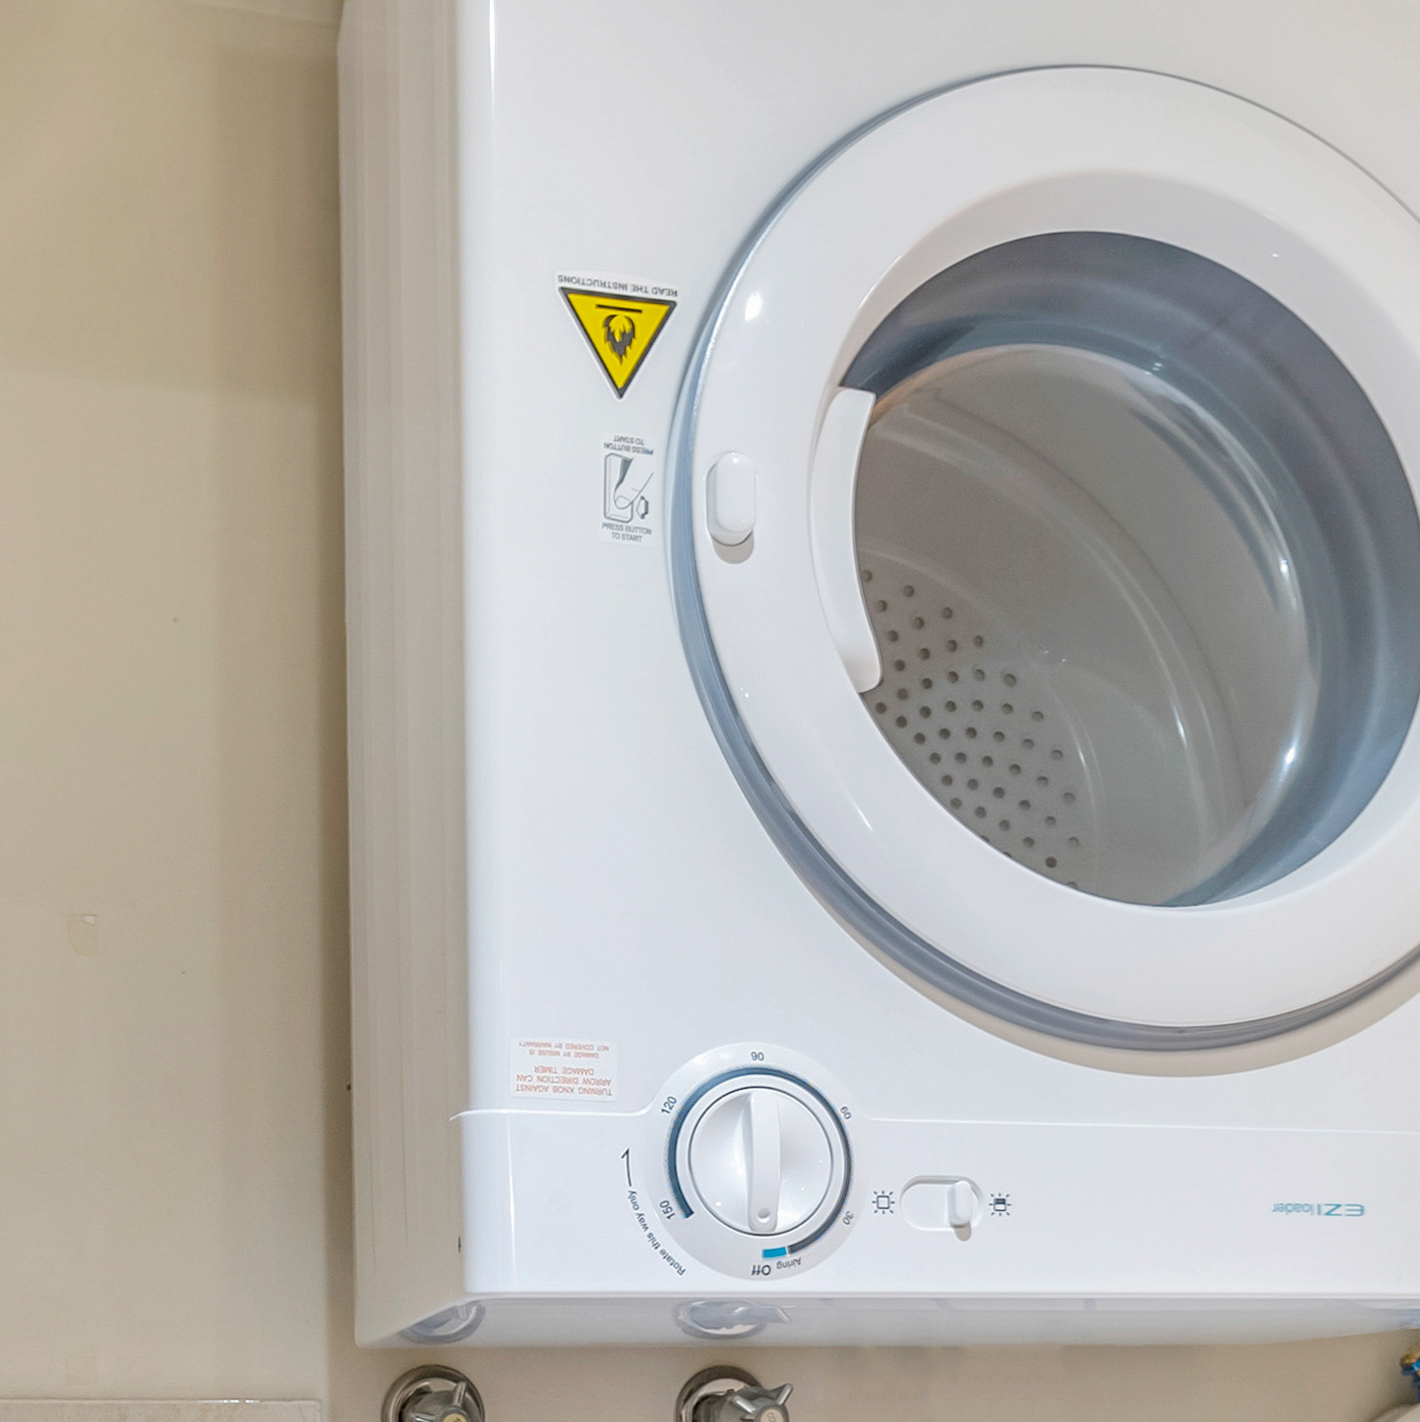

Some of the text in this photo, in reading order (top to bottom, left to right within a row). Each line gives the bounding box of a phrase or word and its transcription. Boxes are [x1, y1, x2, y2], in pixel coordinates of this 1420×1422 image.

[558, 275, 678, 297] READ THE INSTRUCTIONS
[613, 435, 644, 446] TO START
[603, 442, 654, 455] PRESS BUTTON
[601, 522, 653, 535] PRESS BUTTON
[611, 532, 642, 542] TO START
[751, 1051, 764, 1062] 90
[534, 1065, 594, 1075] DAMAGE TIMER
[516, 1074, 533, 1082] CAN
[537, 1075, 579, 1083] DIRECTION
[516, 1084, 612, 1096] TURNING KNOB AGAINST
[660, 1095, 678, 1115] 120
[840, 1106, 852, 1120] 60
[659, 1200, 676, 1220] 150
[1272, 1203, 1313, 1215] loader
[842, 1210, 854, 1225] 30
[627, 1190, 686, 1276] Rotate this way only
[751, 1257, 802, 1276] Airing Off
